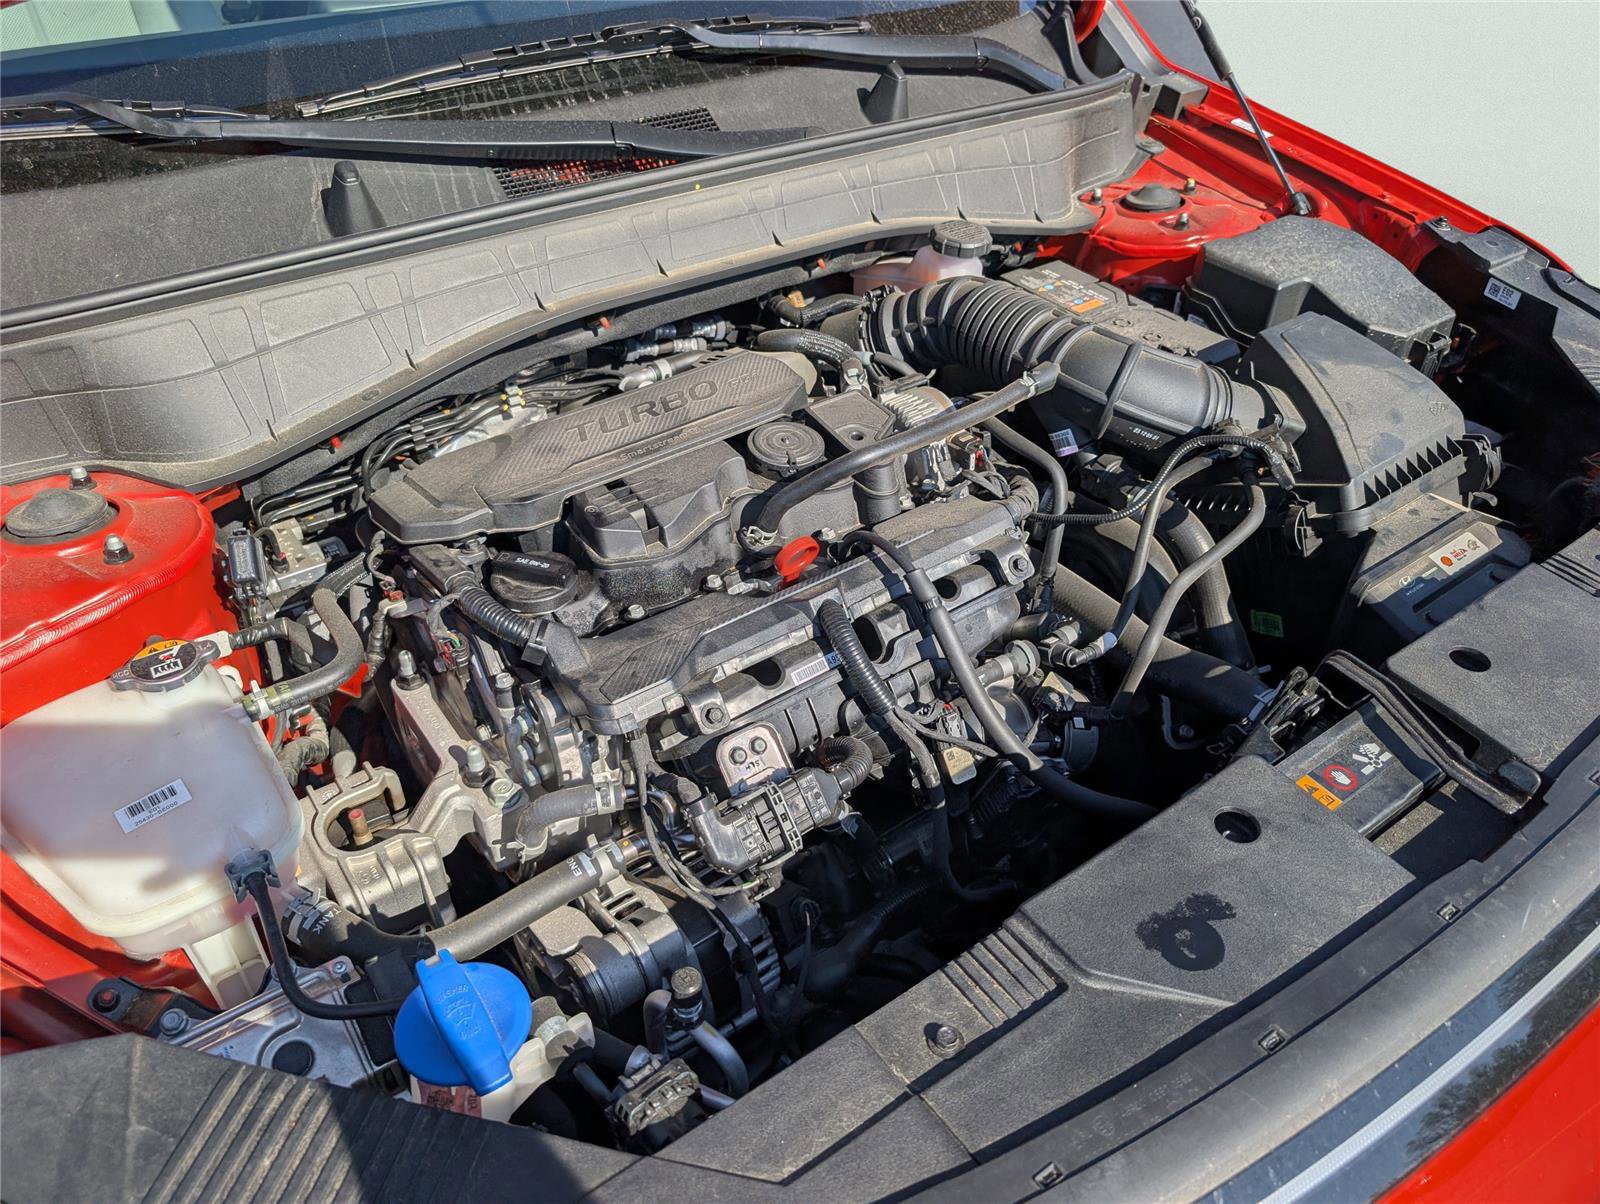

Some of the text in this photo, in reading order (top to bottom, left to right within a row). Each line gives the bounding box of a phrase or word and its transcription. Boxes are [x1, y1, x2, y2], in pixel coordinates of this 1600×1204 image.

[566, 380, 718, 443] TURBO
[566, 857, 583, 877] ENG
[312, 907, 342, 935] TANK
